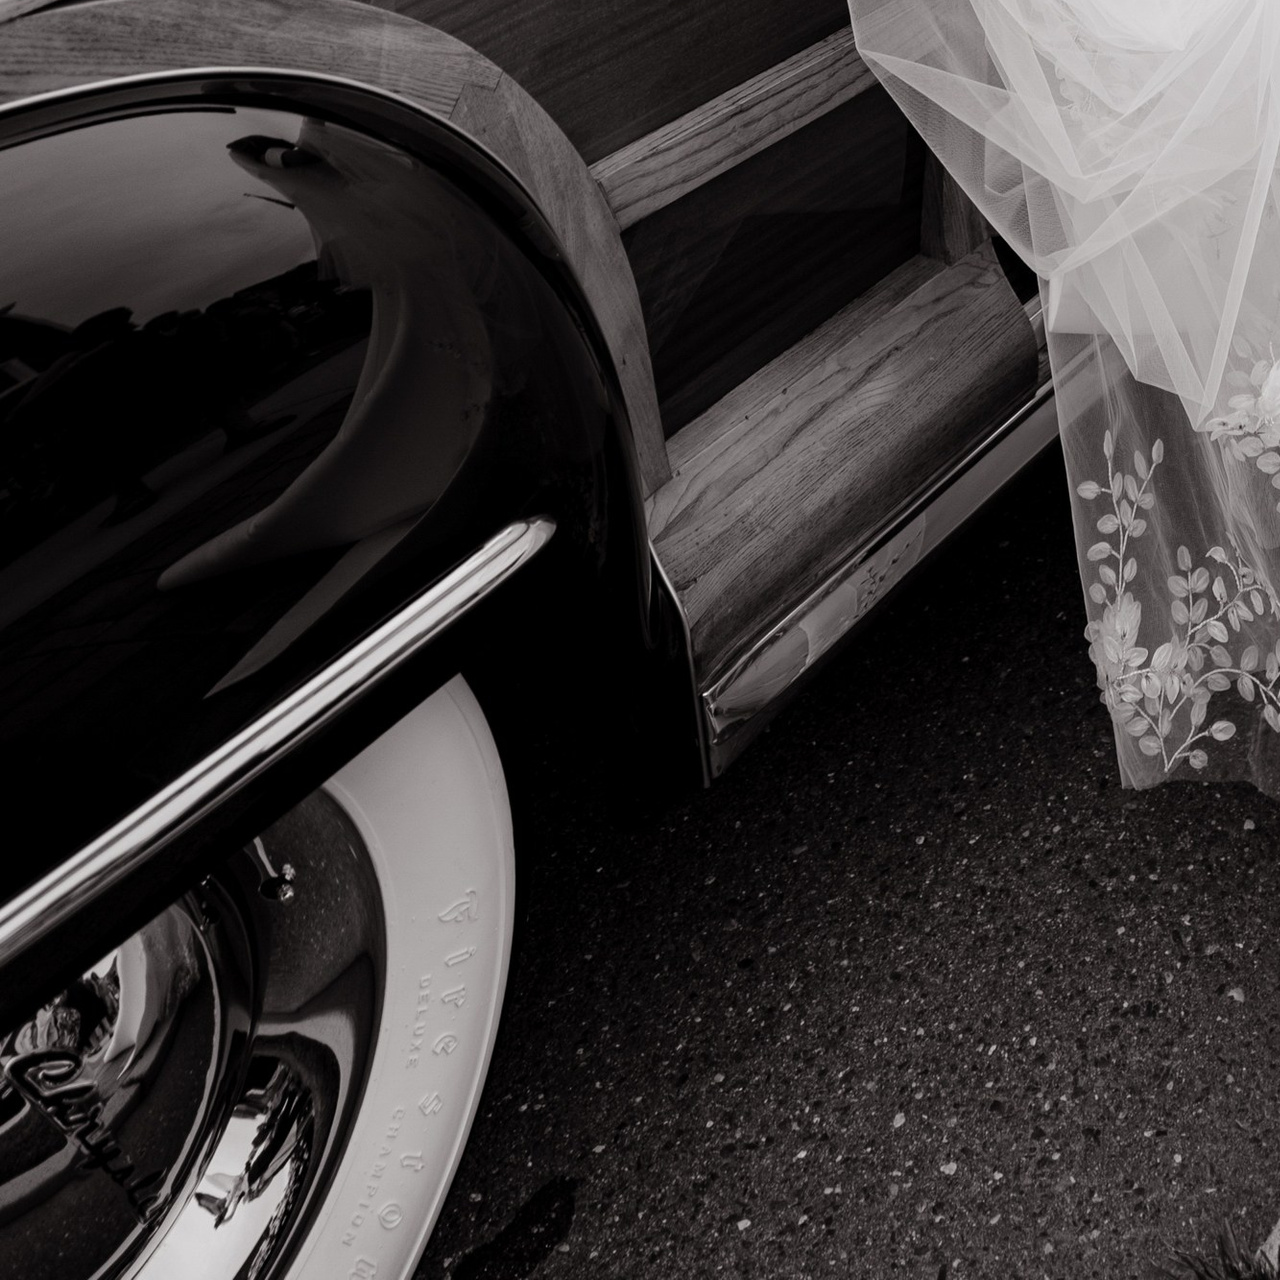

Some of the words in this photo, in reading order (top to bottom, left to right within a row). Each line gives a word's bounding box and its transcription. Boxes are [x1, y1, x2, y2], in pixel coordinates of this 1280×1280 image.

[405, 973, 432, 1070] DELUXE
[4, 1049, 172, 1226] Chrysle
[342, 1108, 406, 1247] CHAMPION
